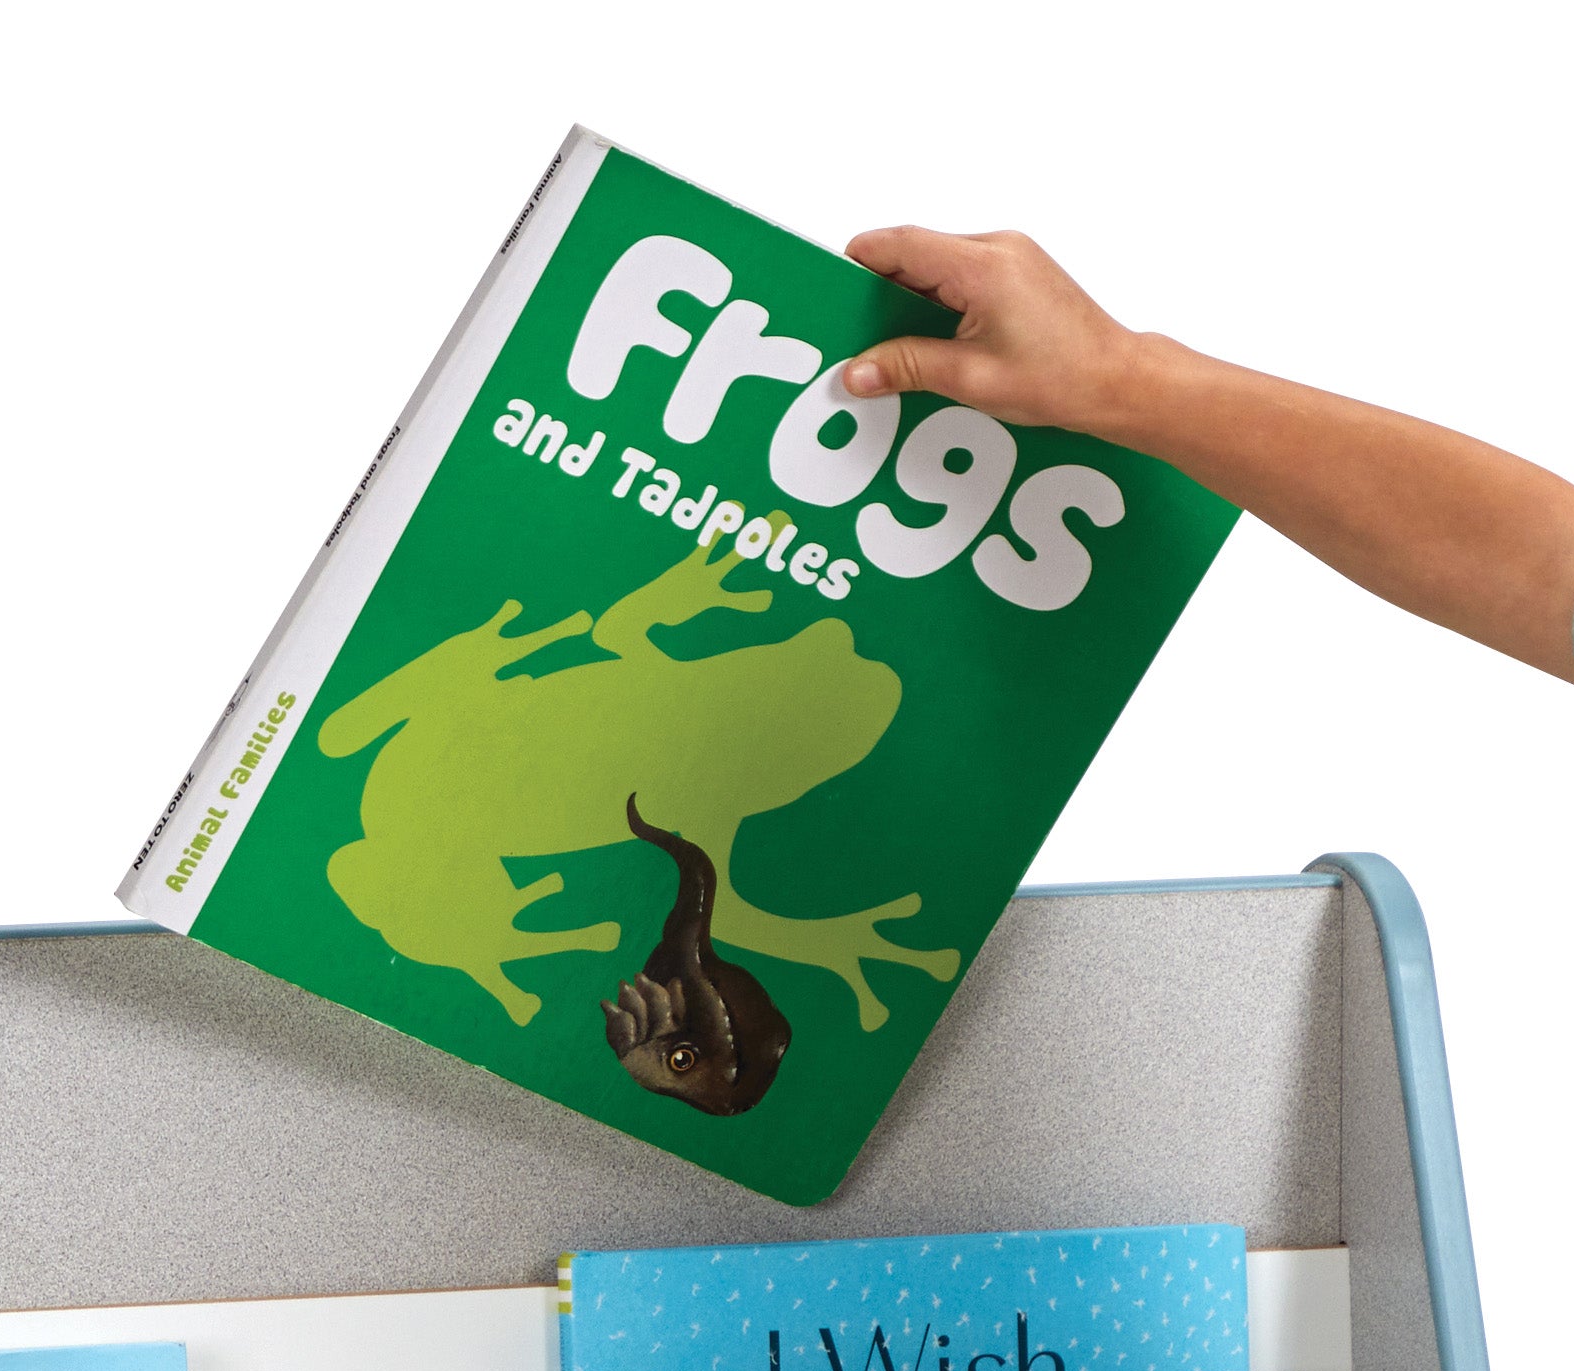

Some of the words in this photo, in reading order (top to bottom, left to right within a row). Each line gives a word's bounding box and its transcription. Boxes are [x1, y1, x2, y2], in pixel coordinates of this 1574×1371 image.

[377, 425, 401, 461] Frogs
[567, 234, 1126, 611] Frogs
[360, 463, 378, 490] and
[326, 492, 362, 548] Tadpoles
[494, 397, 606, 479] and
[620, 442, 860, 601] Tadpoles
[165, 806, 229, 893] Animal
[219, 691, 297, 800] Families
[168, 771, 195, 814] ZERO
[154, 815, 170, 837] TO
[133, 838, 156, 870] TEN
